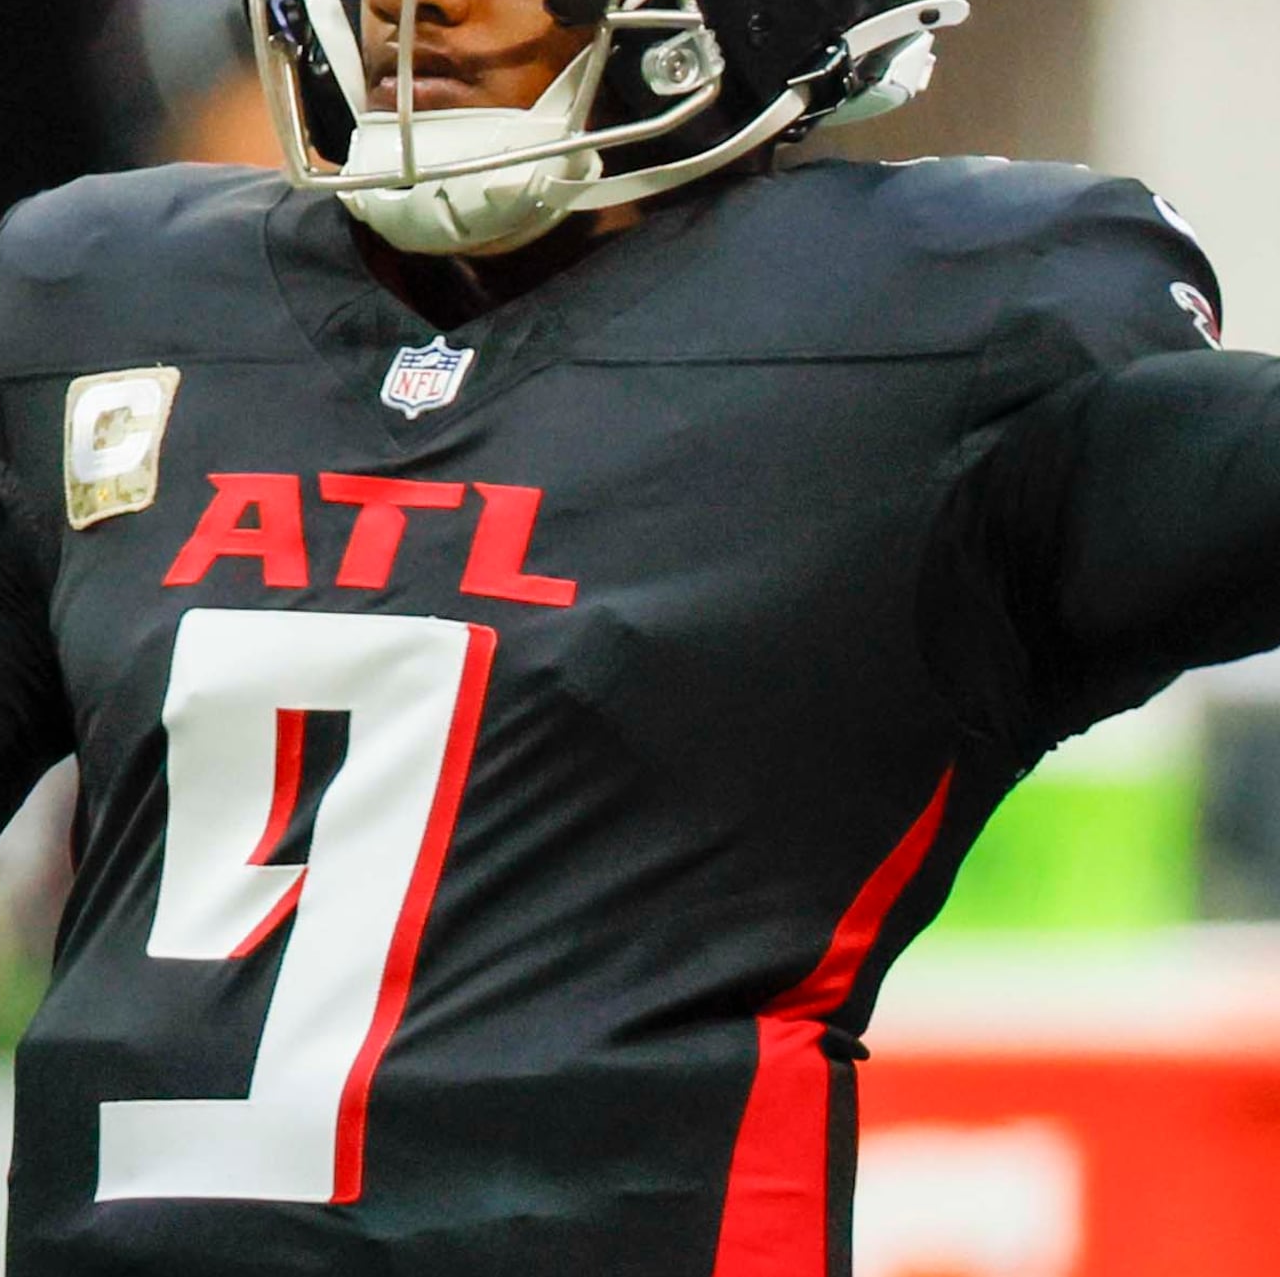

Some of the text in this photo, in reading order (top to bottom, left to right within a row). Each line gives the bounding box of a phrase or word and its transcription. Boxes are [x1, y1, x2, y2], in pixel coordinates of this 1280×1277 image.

[72, 377, 162, 483] C
[395, 370, 440, 401] NFL
[162, 471, 578, 607] ATL
[93, 607, 498, 1204] 9
